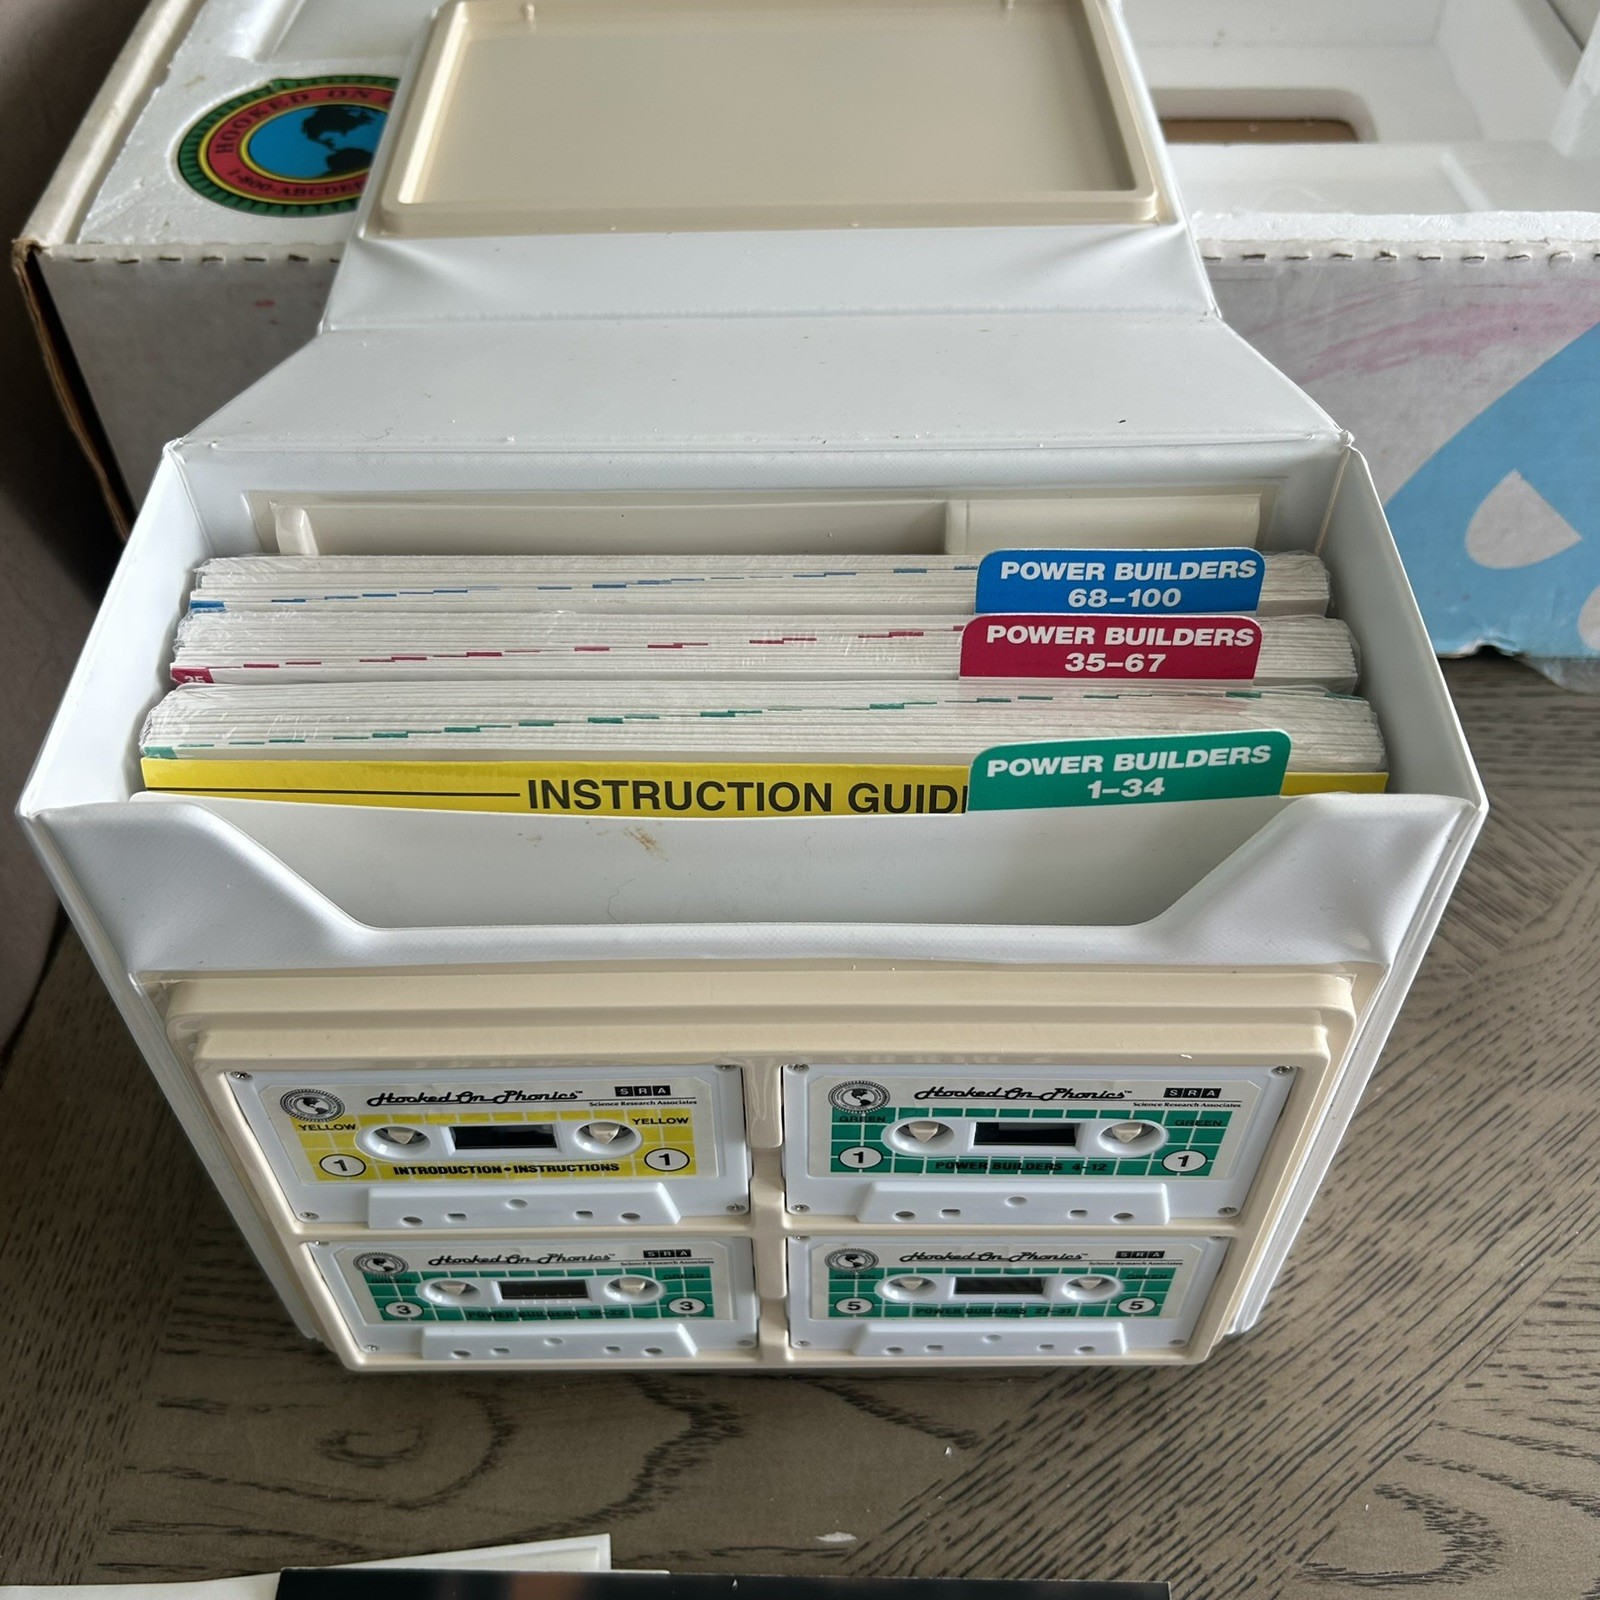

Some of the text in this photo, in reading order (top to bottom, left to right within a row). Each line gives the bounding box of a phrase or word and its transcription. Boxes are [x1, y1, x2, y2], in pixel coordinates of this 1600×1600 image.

[214, 88, 374, 155] HOOKED ON
[1000, 559, 1257, 581] POWER BUILDERS
[1067, 588, 1182, 608] 68–100
[986, 624, 1254, 647] POWER BUILDERS
[1064, 652, 1166, 673] 35–67
[987, 745, 1272, 778] POWER BUILDERS
[1087, 777, 1165, 799] 1–34
[527, 779, 832, 813] INSTRUCTION
[366, 1091, 452, 1106] Hooked
[455, 1090, 488, 1105] On
[913, 1086, 1001, 1100] Hooked
[1004, 1087, 1034, 1099] On
[632, 1117, 690, 1126] YELLOW
[839, 1115, 887, 1123] GREEN
[1174, 1119, 1223, 1127] GREEN
[298, 1123, 356, 1132] YELLOW
[658, 1153, 671, 1166] 1
[853, 1151, 864, 1164] 1
[1177, 1154, 1190, 1167] 1
[333, 1158, 348, 1172] 1
[935, 1161, 988, 1171] POWER
[991, 1161, 1063, 1171] BUILDERS
[428, 1254, 502, 1266] Hooked
[505, 1253, 532, 1265] On
[899, 1251, 974, 1263] Hooked
[977, 1251, 1003, 1262] On
[396, 1305, 411, 1315] 3
[679, 1301, 694, 1311] 3
[847, 1301, 861, 1311] 5
[1129, 1301, 1144, 1310] 5
